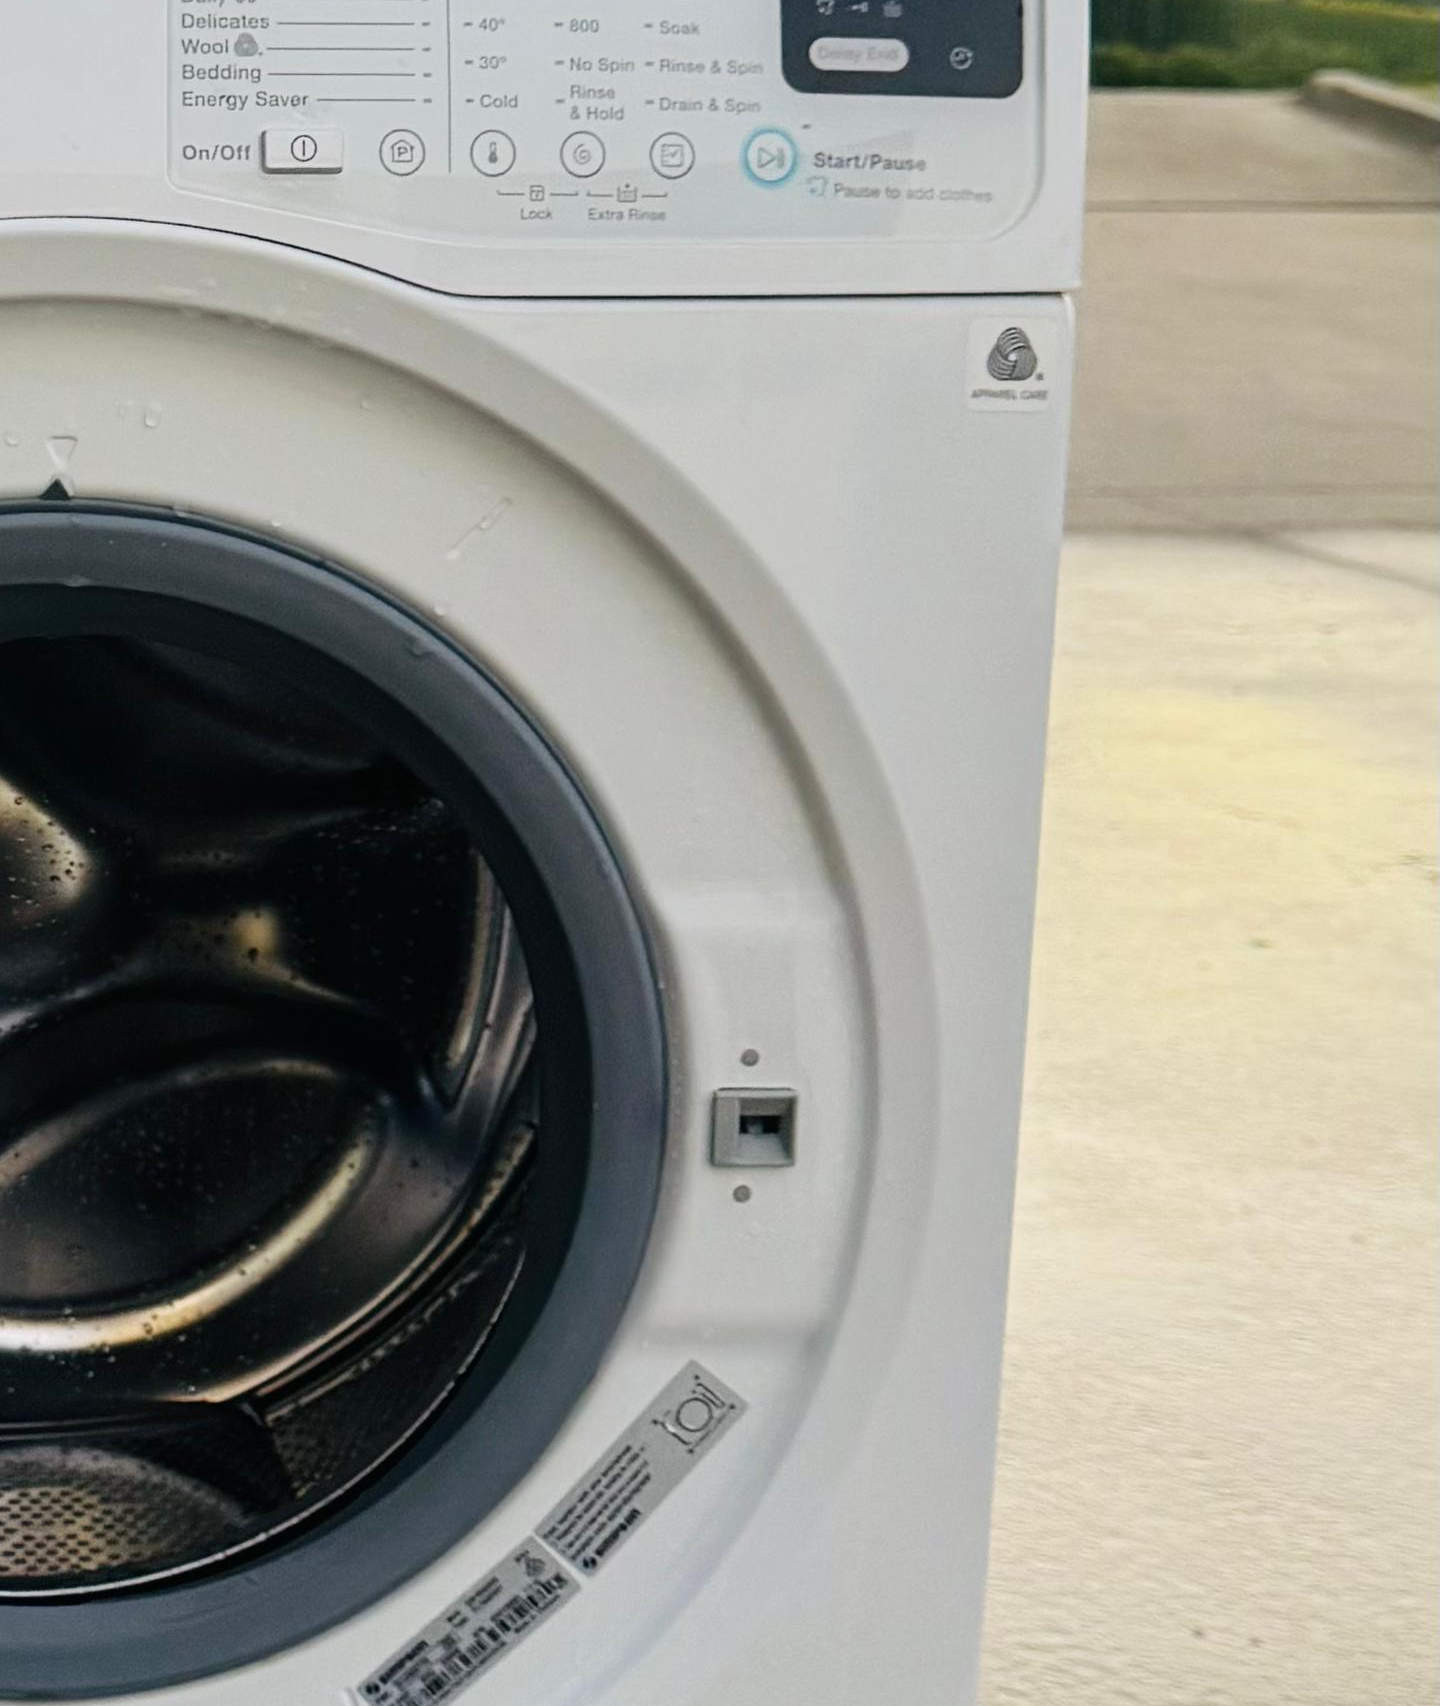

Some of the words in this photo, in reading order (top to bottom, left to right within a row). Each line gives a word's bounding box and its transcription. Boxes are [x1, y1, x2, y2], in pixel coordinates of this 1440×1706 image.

[181, 13, 270, 29] Delicates
[478, 18, 505, 32] 40°
[570, 20, 599, 32] 800
[660, 21, 700, 35] Soak
[182, 39, 229, 54] Wool
[479, 55, 507, 69] 30°
[570, 58, 593, 71] No
[597, 58, 635, 74] Spin
[660, 59, 705, 73] Rinse
[711, 60, 721, 73] &
[727, 60, 763, 75] Spin
[182, 65, 262, 83] Bedding
[570, 85, 615, 99] Rinse
[183, 92, 248, 110] Energy
[256, 92, 308, 107] Saver
[480, 94, 518, 109] Cold
[660, 98, 702, 112] Drain
[708, 99, 719, 112] &
[724, 99, 761, 115] Spin
[570, 107, 581, 120] &
[587, 107, 624, 121] Hold
[183, 145, 251, 161] On/Off
[814, 153, 926, 172] Start/Pause
[520, 207, 553, 221] Lock
[588, 208, 623, 221] Extra
[628, 208, 666, 222] Rinse
